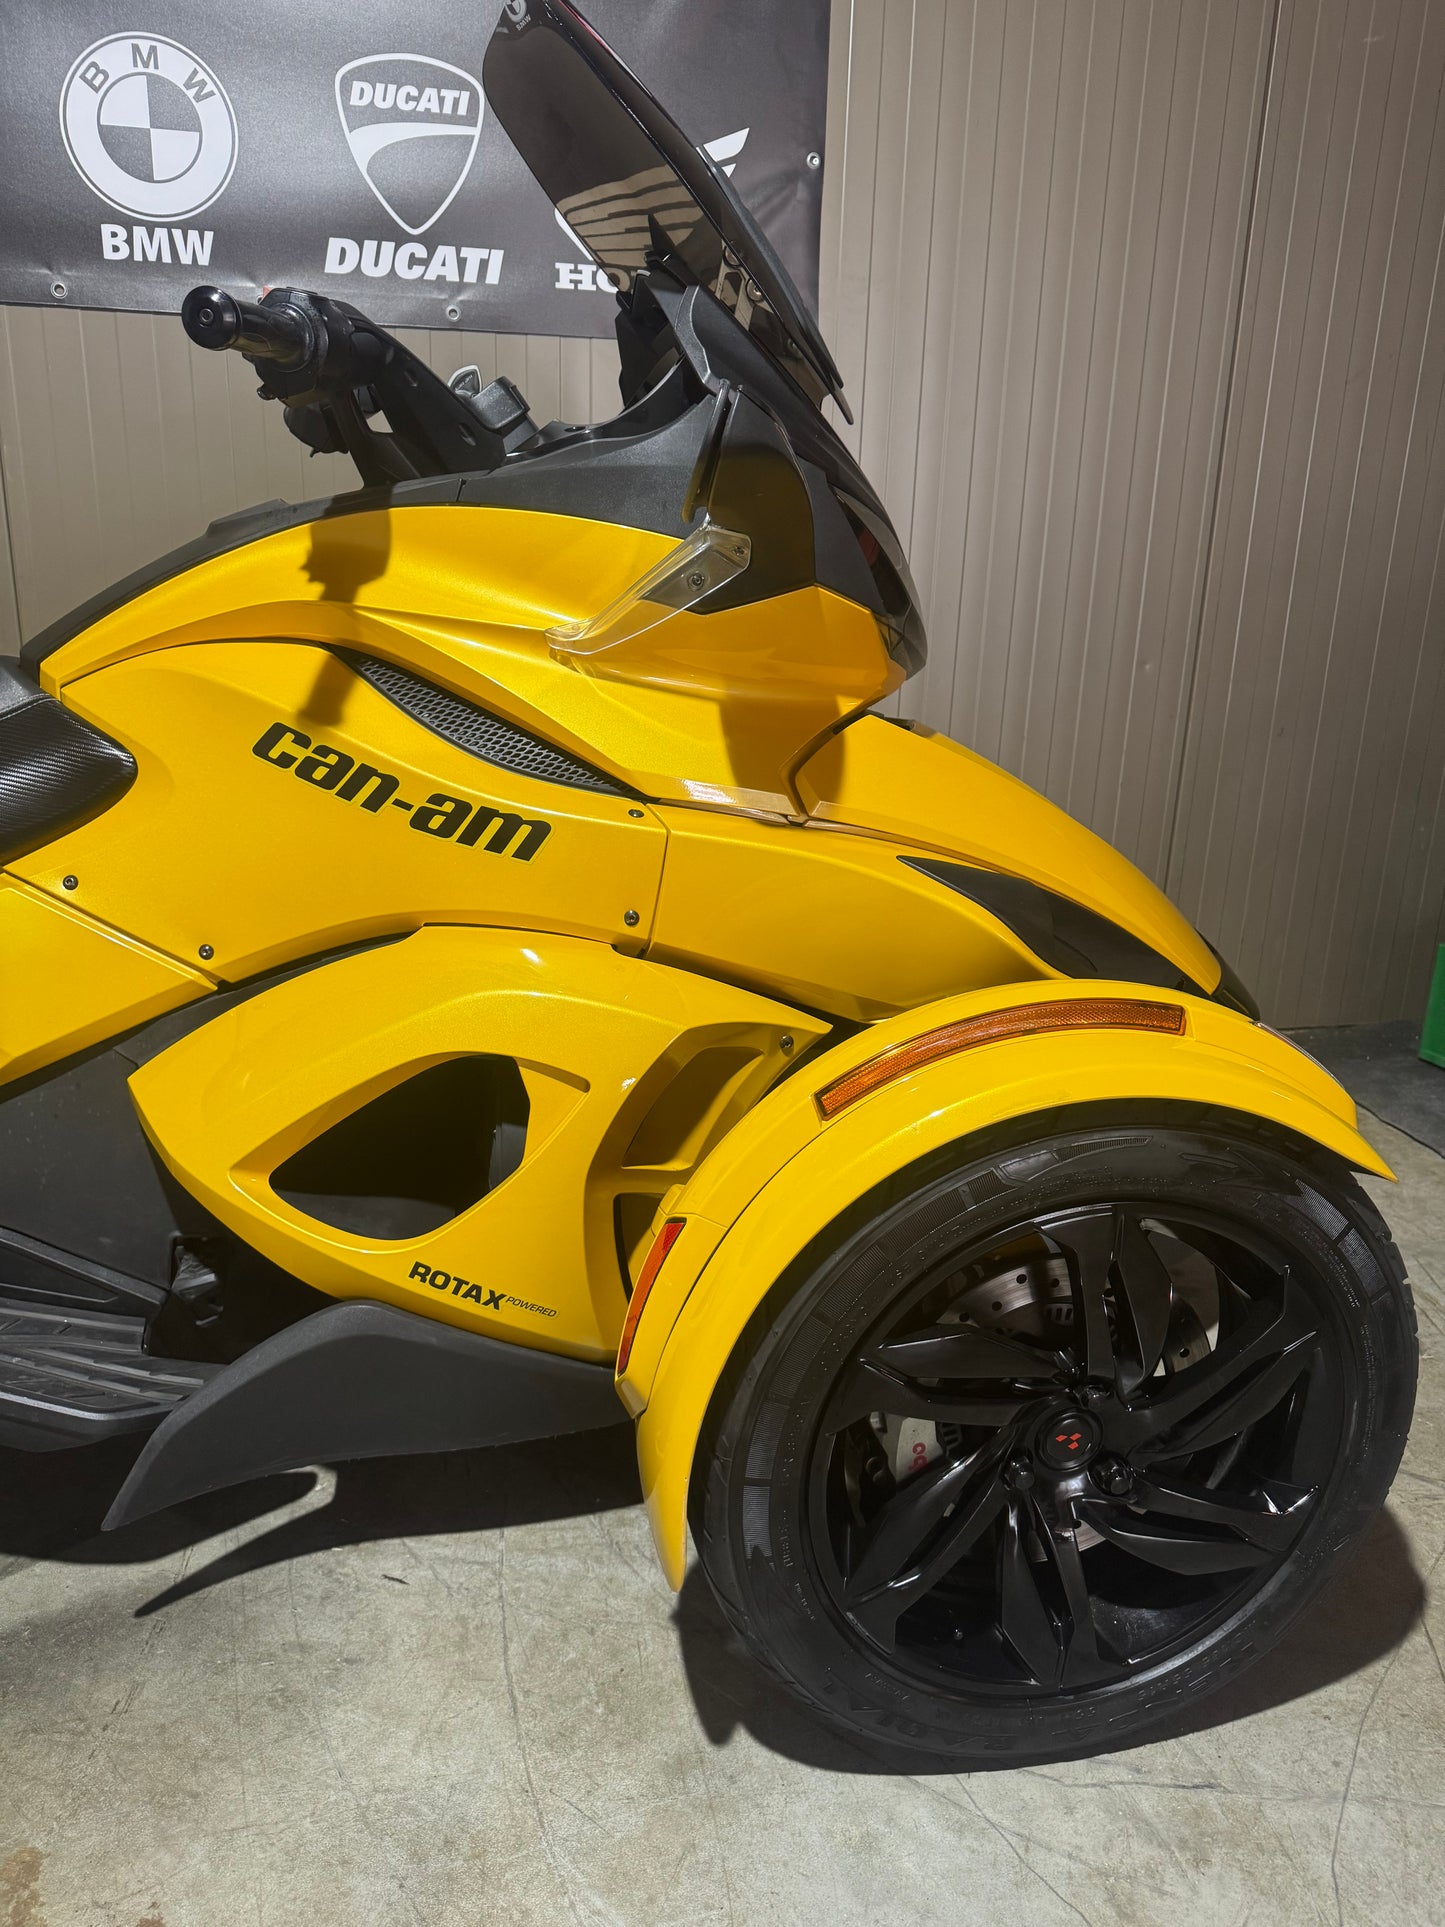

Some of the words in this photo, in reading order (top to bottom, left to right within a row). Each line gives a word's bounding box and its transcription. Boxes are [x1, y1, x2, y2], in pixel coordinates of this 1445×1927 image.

[79, 43, 216, 103] BMW
[350, 81, 470, 116] DUCATI
[100, 223, 214, 266] BMW
[324, 237, 504, 285] DUCATI
[555, 262, 634, 294] HO
[252, 721, 552, 862] can-am
[408, 1261, 507, 1310] ROTAX
[505, 1296, 558, 1318] POWERED
